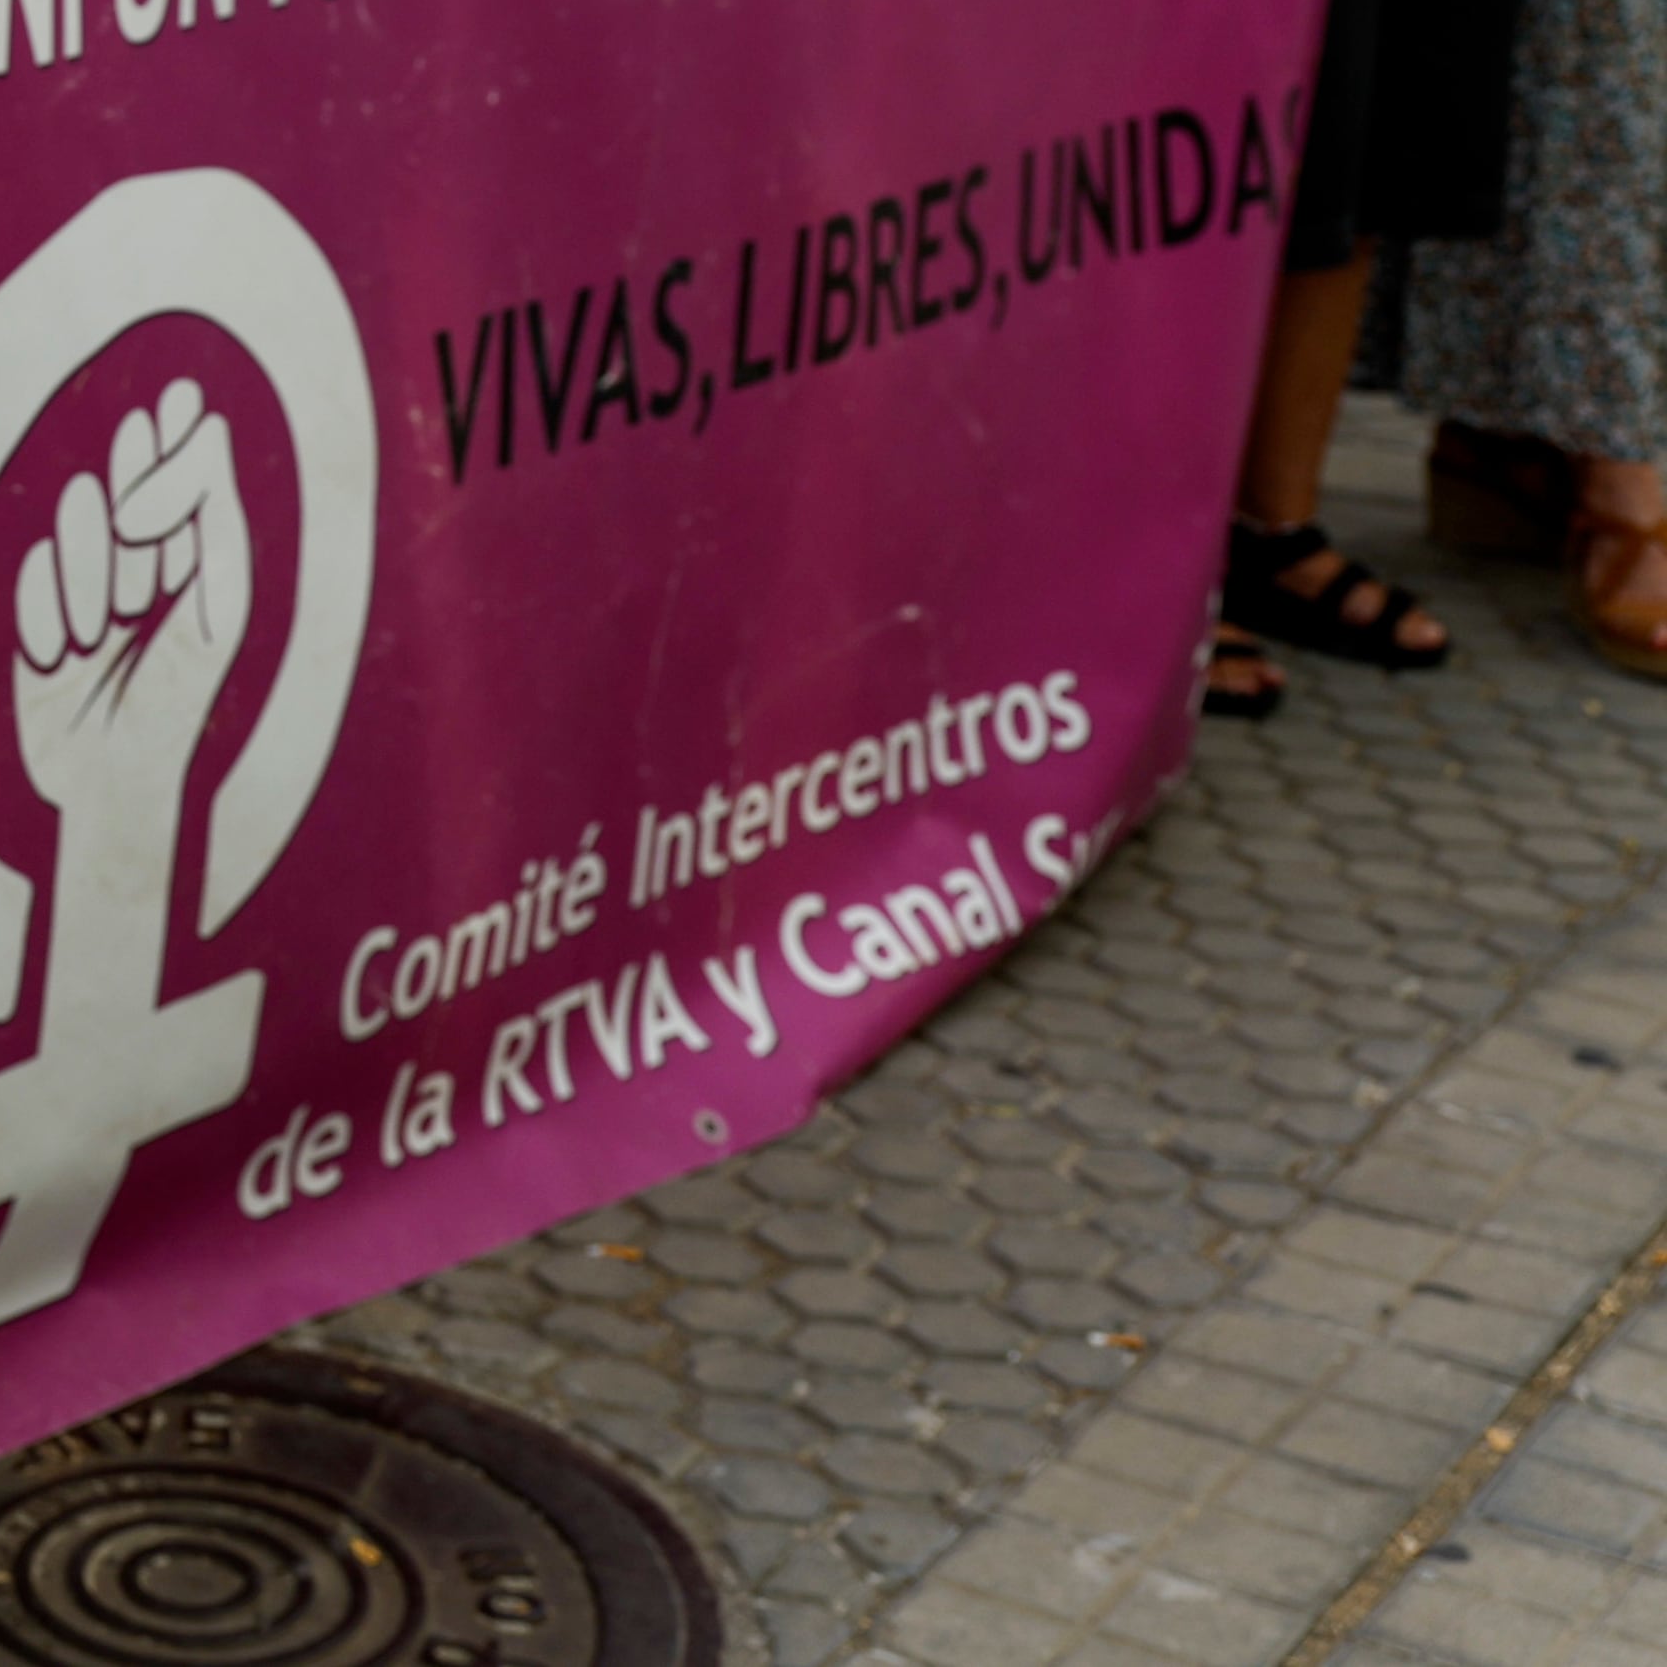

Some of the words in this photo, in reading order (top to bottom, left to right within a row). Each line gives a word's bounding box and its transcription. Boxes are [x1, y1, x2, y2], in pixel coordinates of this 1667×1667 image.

[434, 258, 713, 487] VIVAS,
[729, 166, 1009, 392] LIBRES,
[236, 1105, 353, 1222] de
[378, 1059, 456, 1170] la
[483, 949, 713, 1129] RTVA
[704, 944, 780, 1059] y
[780, 833, 1023, 999] Canal
[338, 821, 609, 1044] Comité
[629, 668, 1092, 911] Intercentros
